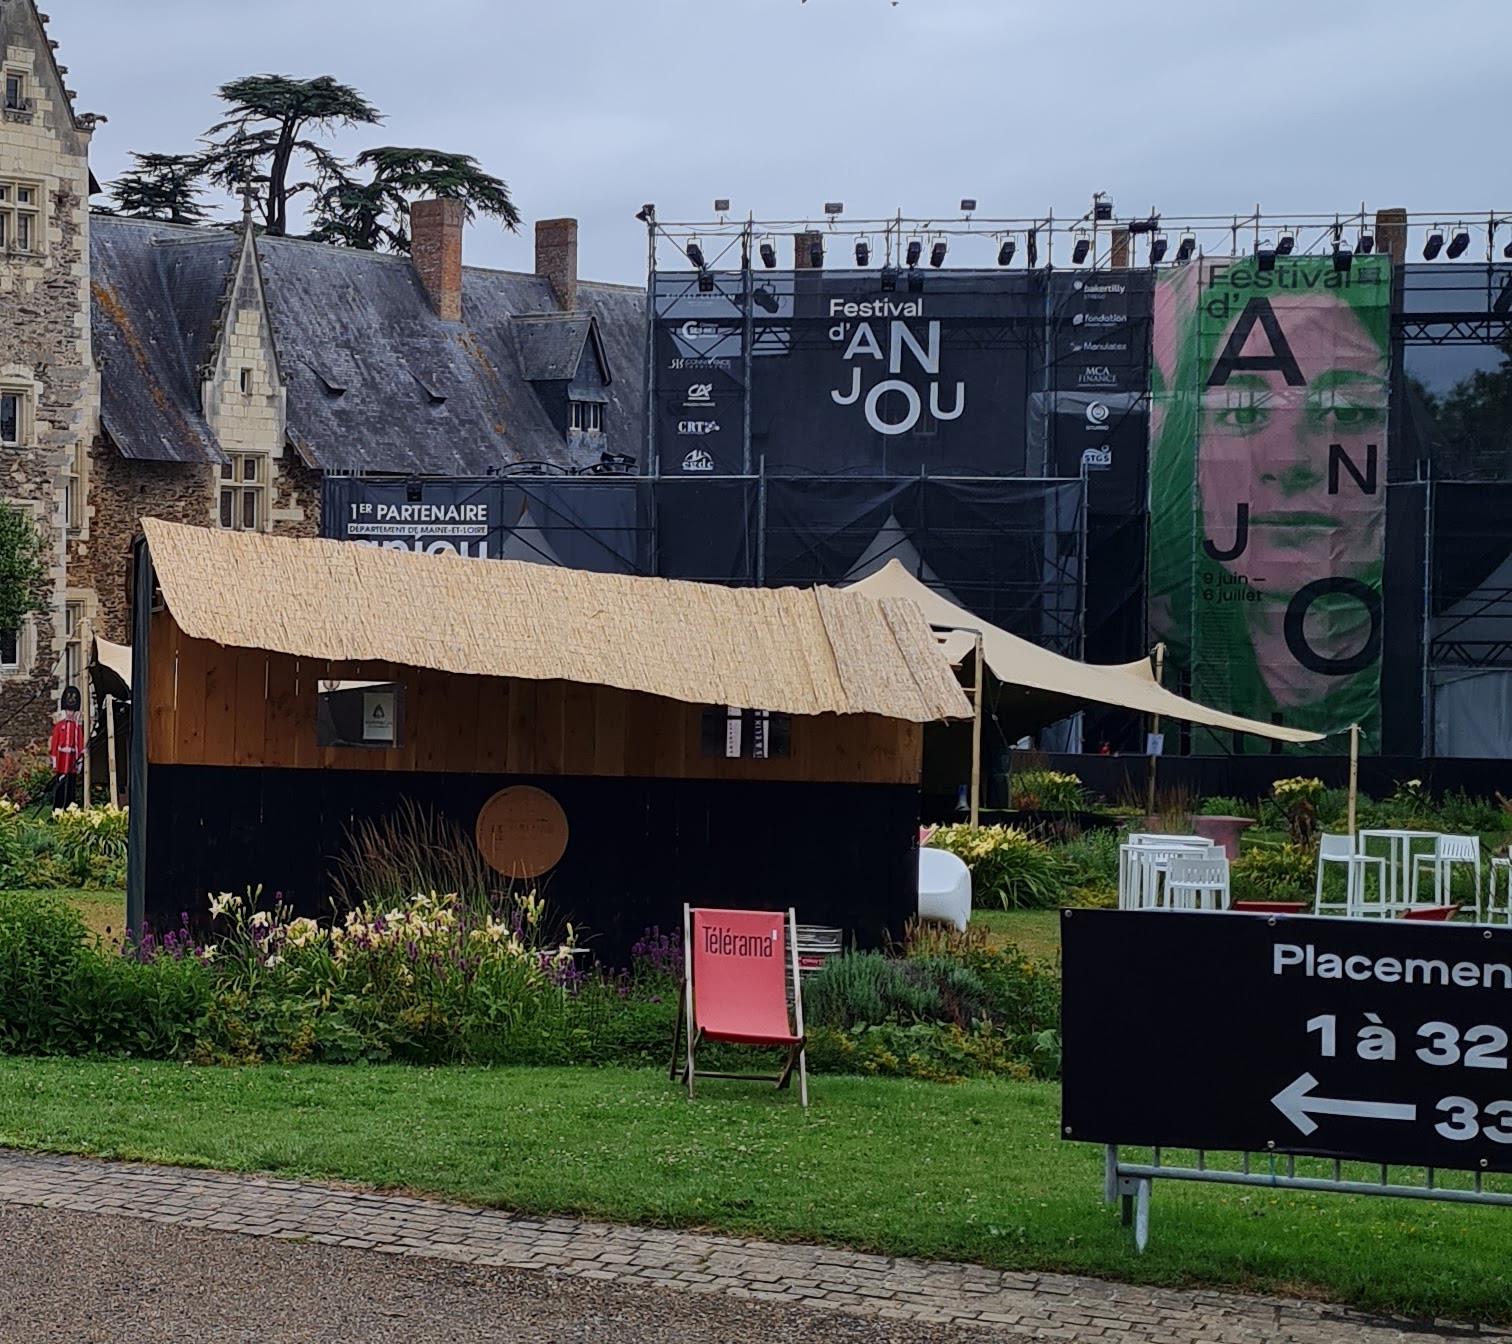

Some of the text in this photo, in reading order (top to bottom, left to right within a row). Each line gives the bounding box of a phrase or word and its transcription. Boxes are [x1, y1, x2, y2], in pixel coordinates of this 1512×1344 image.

[1209, 264, 1351, 289] Festival
[829, 297, 923, 317] Festival
[1085, 366, 1110, 375] MCA
[678, 421, 705, 433] CRT
[377, 504, 487, 521] PARTENAIRE
[407, 525, 419, 534] DE
[420, 526, 486, 534] MAINE-ET-LOIRE
[1203, 572, 1214, 585] 9
[1216, 572, 1249, 588] juin
[1203, 588, 1263, 604] 6 juillet
[702, 926, 773, 957] Télérama
[1306, 1012, 1509, 1070] 1 à 32
